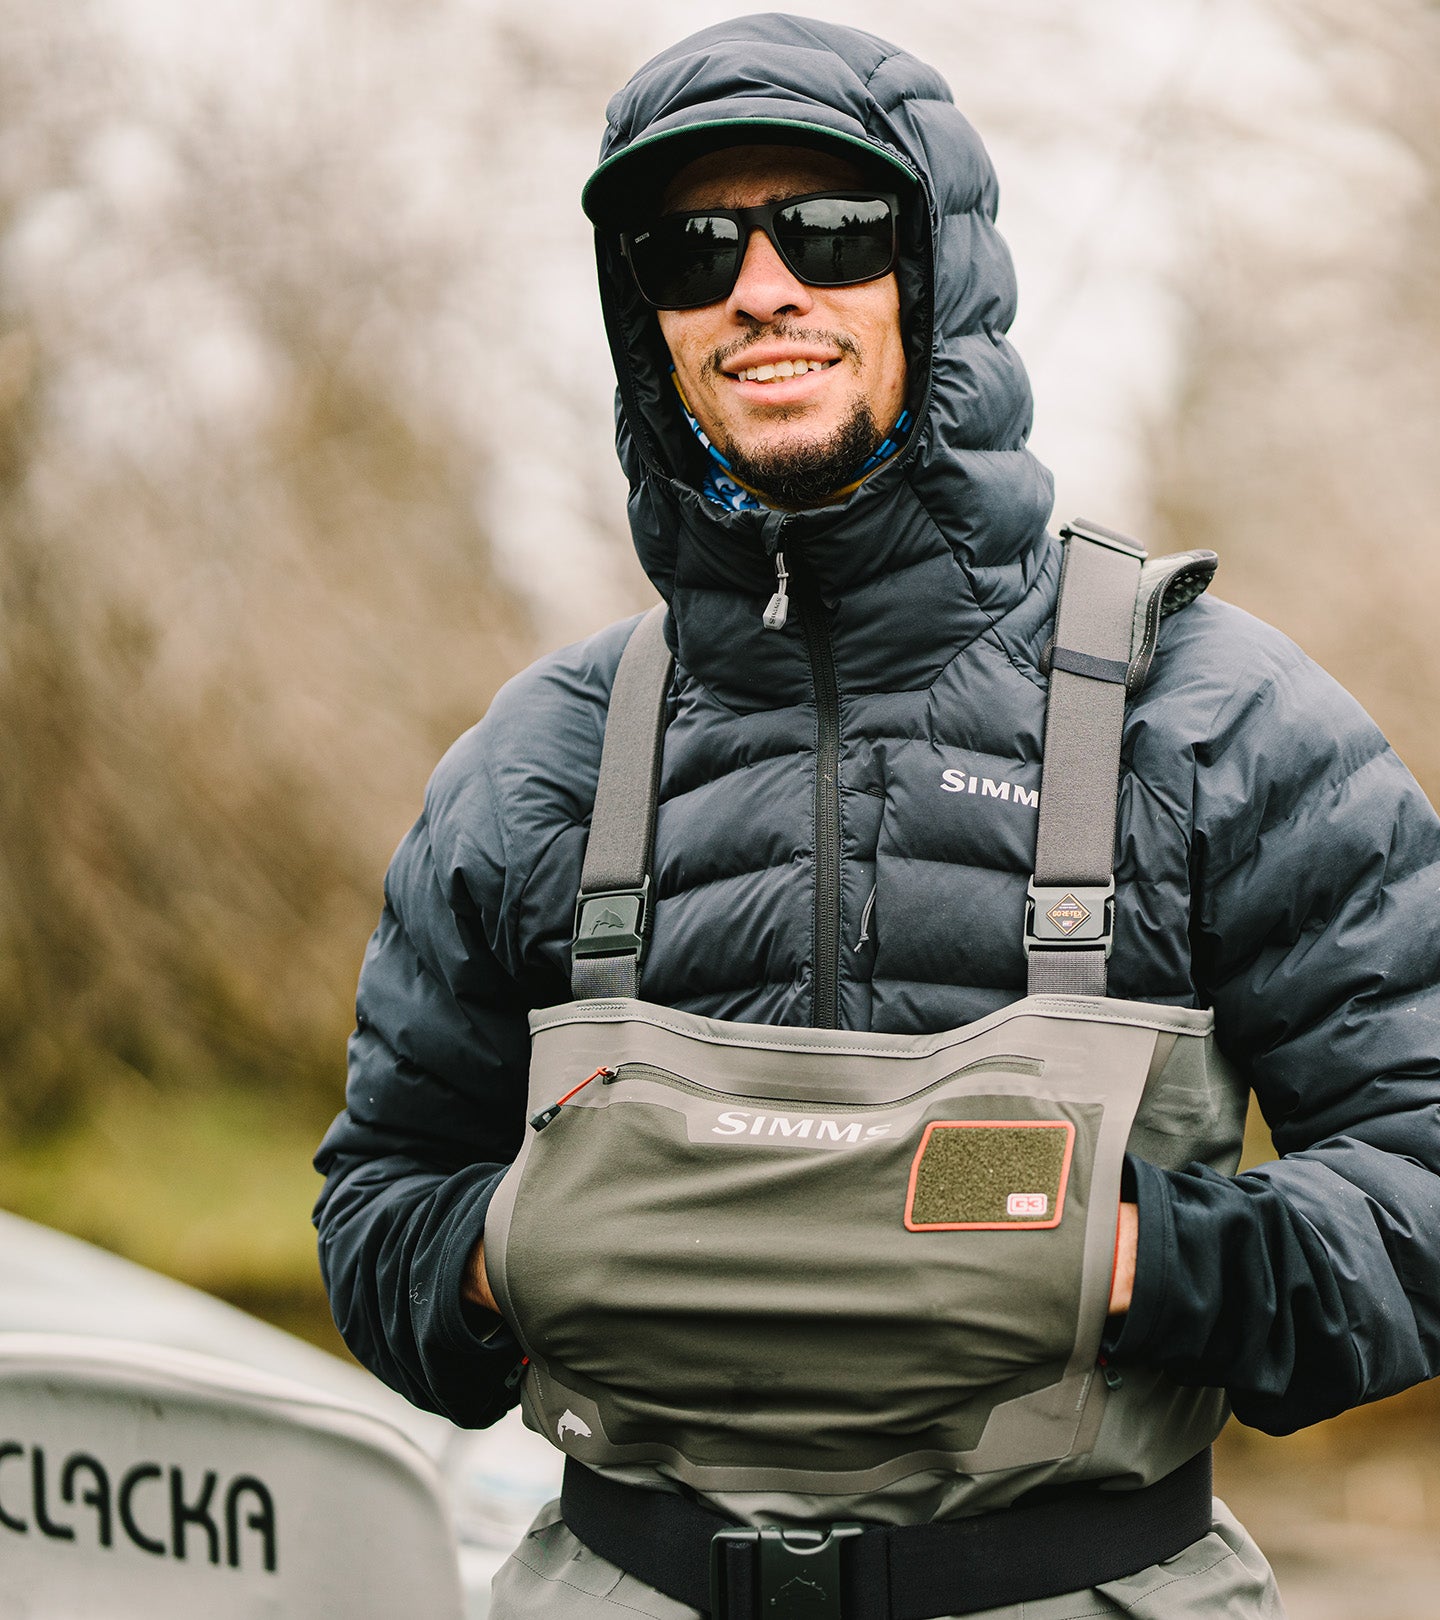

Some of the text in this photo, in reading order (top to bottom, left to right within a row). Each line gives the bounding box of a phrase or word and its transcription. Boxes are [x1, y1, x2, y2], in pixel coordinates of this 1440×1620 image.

[940, 769, 1039, 809] SIMM
[1052, 910, 1083, 918] GORE-TEX
[0, 1439, 277, 1573] CLACKA
